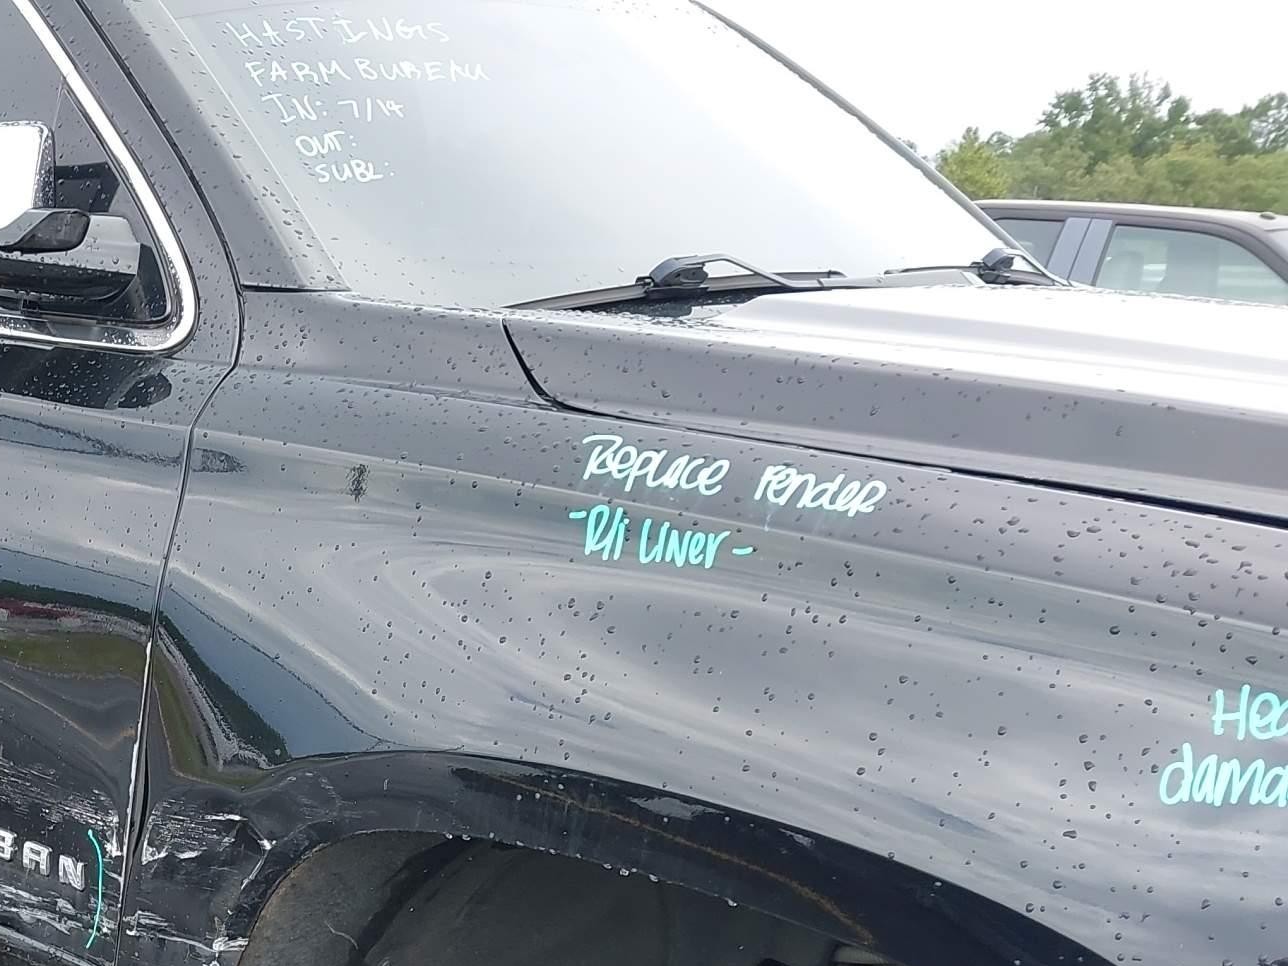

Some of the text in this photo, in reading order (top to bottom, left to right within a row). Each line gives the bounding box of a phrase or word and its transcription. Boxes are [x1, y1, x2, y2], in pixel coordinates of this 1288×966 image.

[225, 16, 451, 46] HASTINGS
[244, 58, 492, 87] FARM BUREAU
[261, 92, 406, 123] IN: 7/14
[295, 130, 358, 157] OUT:
[581, 434, 731, 496] Replace
